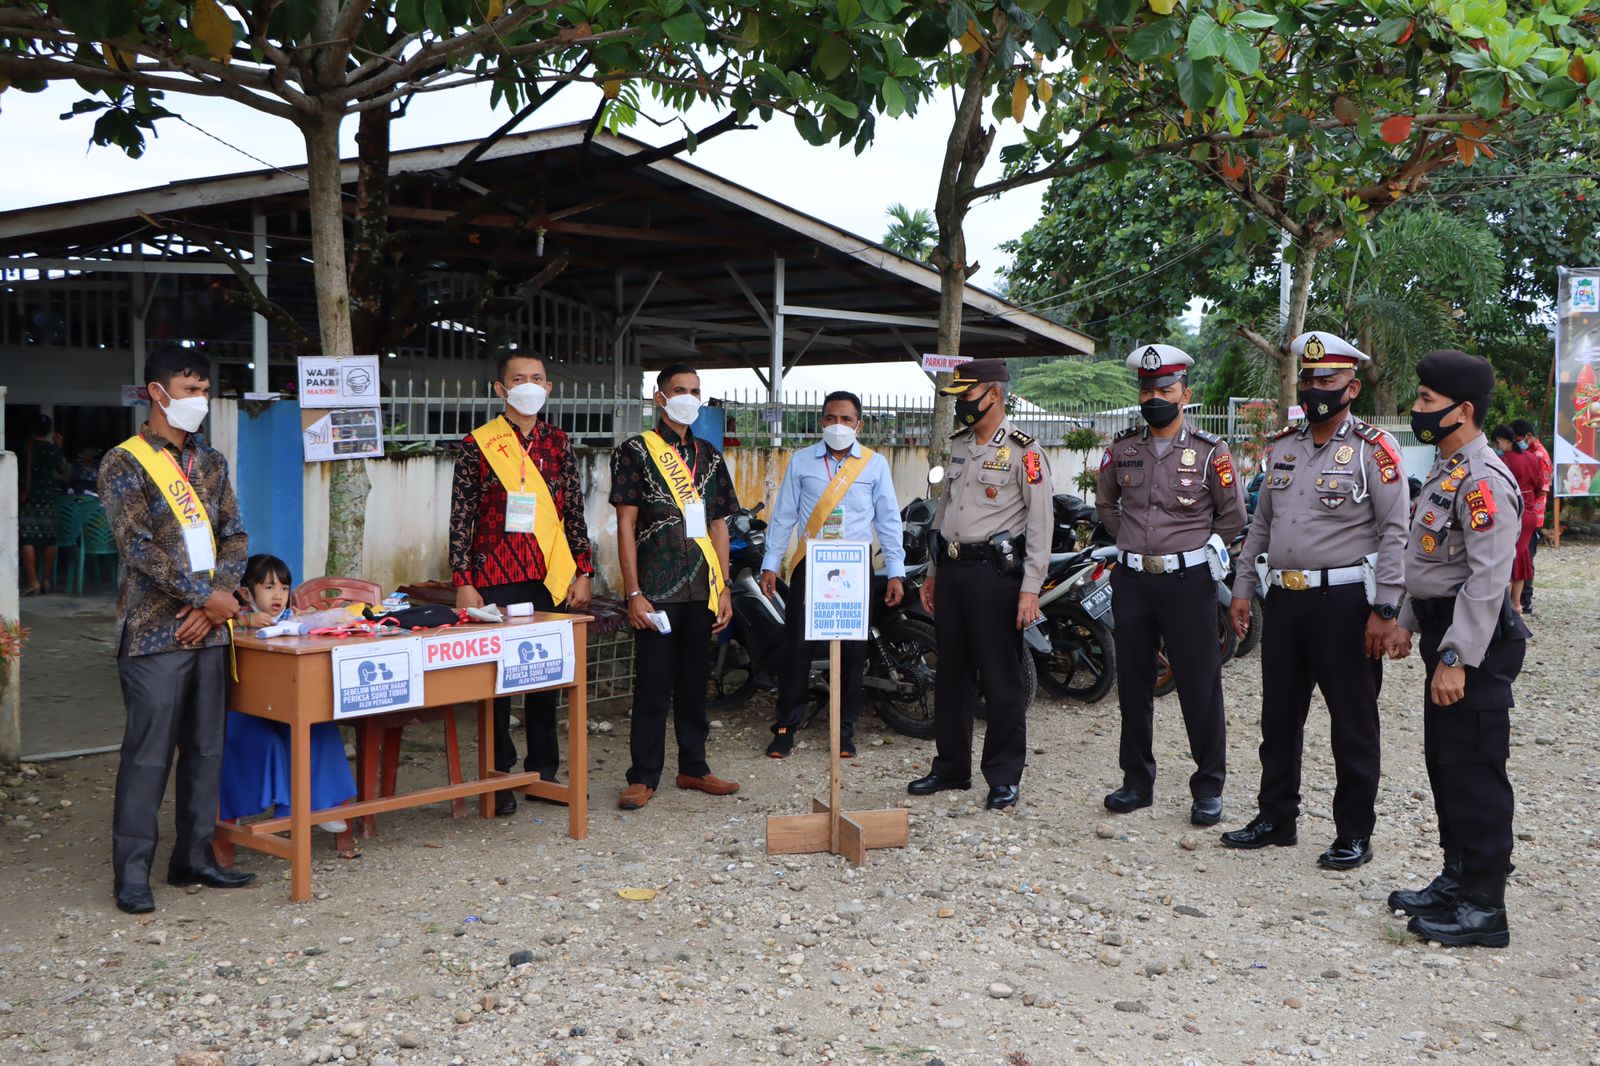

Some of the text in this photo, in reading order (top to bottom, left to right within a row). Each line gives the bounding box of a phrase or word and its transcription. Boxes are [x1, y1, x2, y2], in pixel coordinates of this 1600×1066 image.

[926, 356, 947, 368] PARKIR
[817, 551, 860, 561] PERHATIAN
[814, 602, 862, 610] SEBELUM MASUK
[814, 610, 862, 618] HARAP PERIKSA
[814, 619, 862, 629] SUHU TUBUH
[427, 635, 502, 663] PROKES
[505, 670, 529, 681] PERIKSA
[343, 680, 408, 696] SEBELUM MASUK HARAP
[343, 687, 408, 704] PERIKSA SUHU TUBUH
